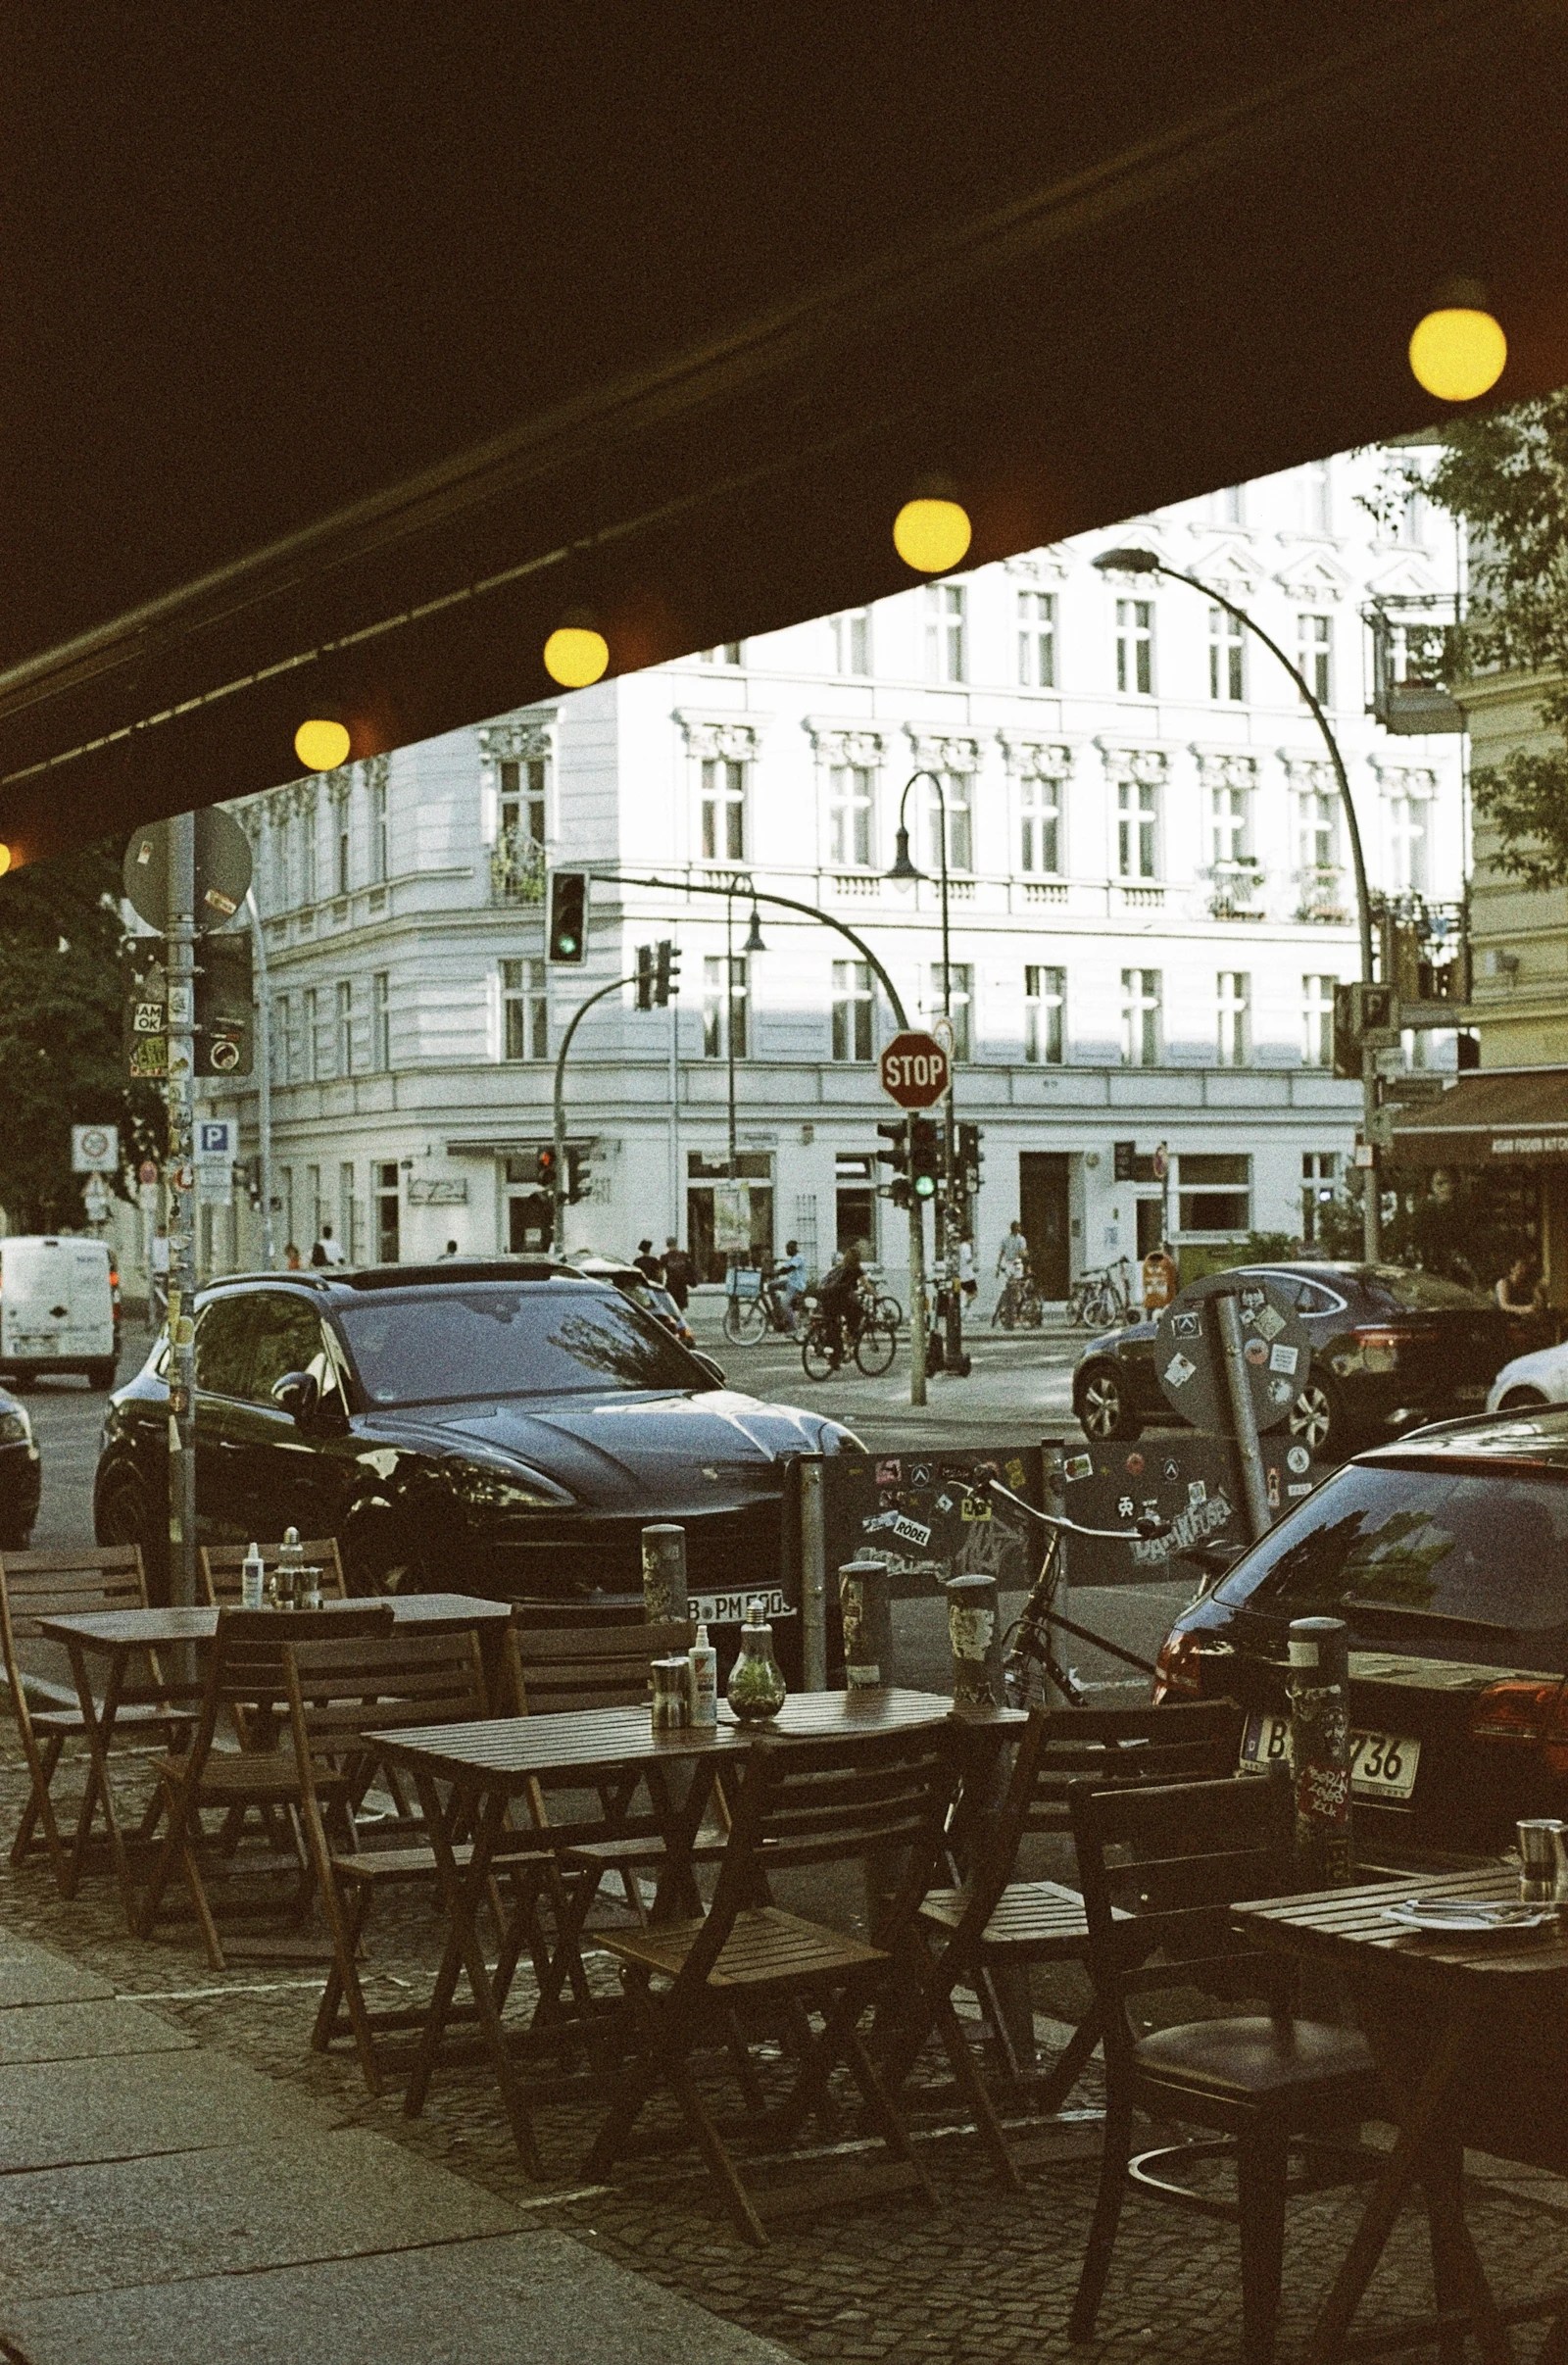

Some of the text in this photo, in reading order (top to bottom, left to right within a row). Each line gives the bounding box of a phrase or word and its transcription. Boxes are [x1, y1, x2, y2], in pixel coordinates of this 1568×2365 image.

[138, 1017, 158, 1030] OK
[886, 1055, 944, 1087] STOP
[207, 1128, 222, 1149] P
[896, 1521, 927, 1544] RÖDEL
[687, 1600, 700, 1620] B
[715, 1597, 742, 1618] PM
[1267, 1719, 1288, 1758] B
